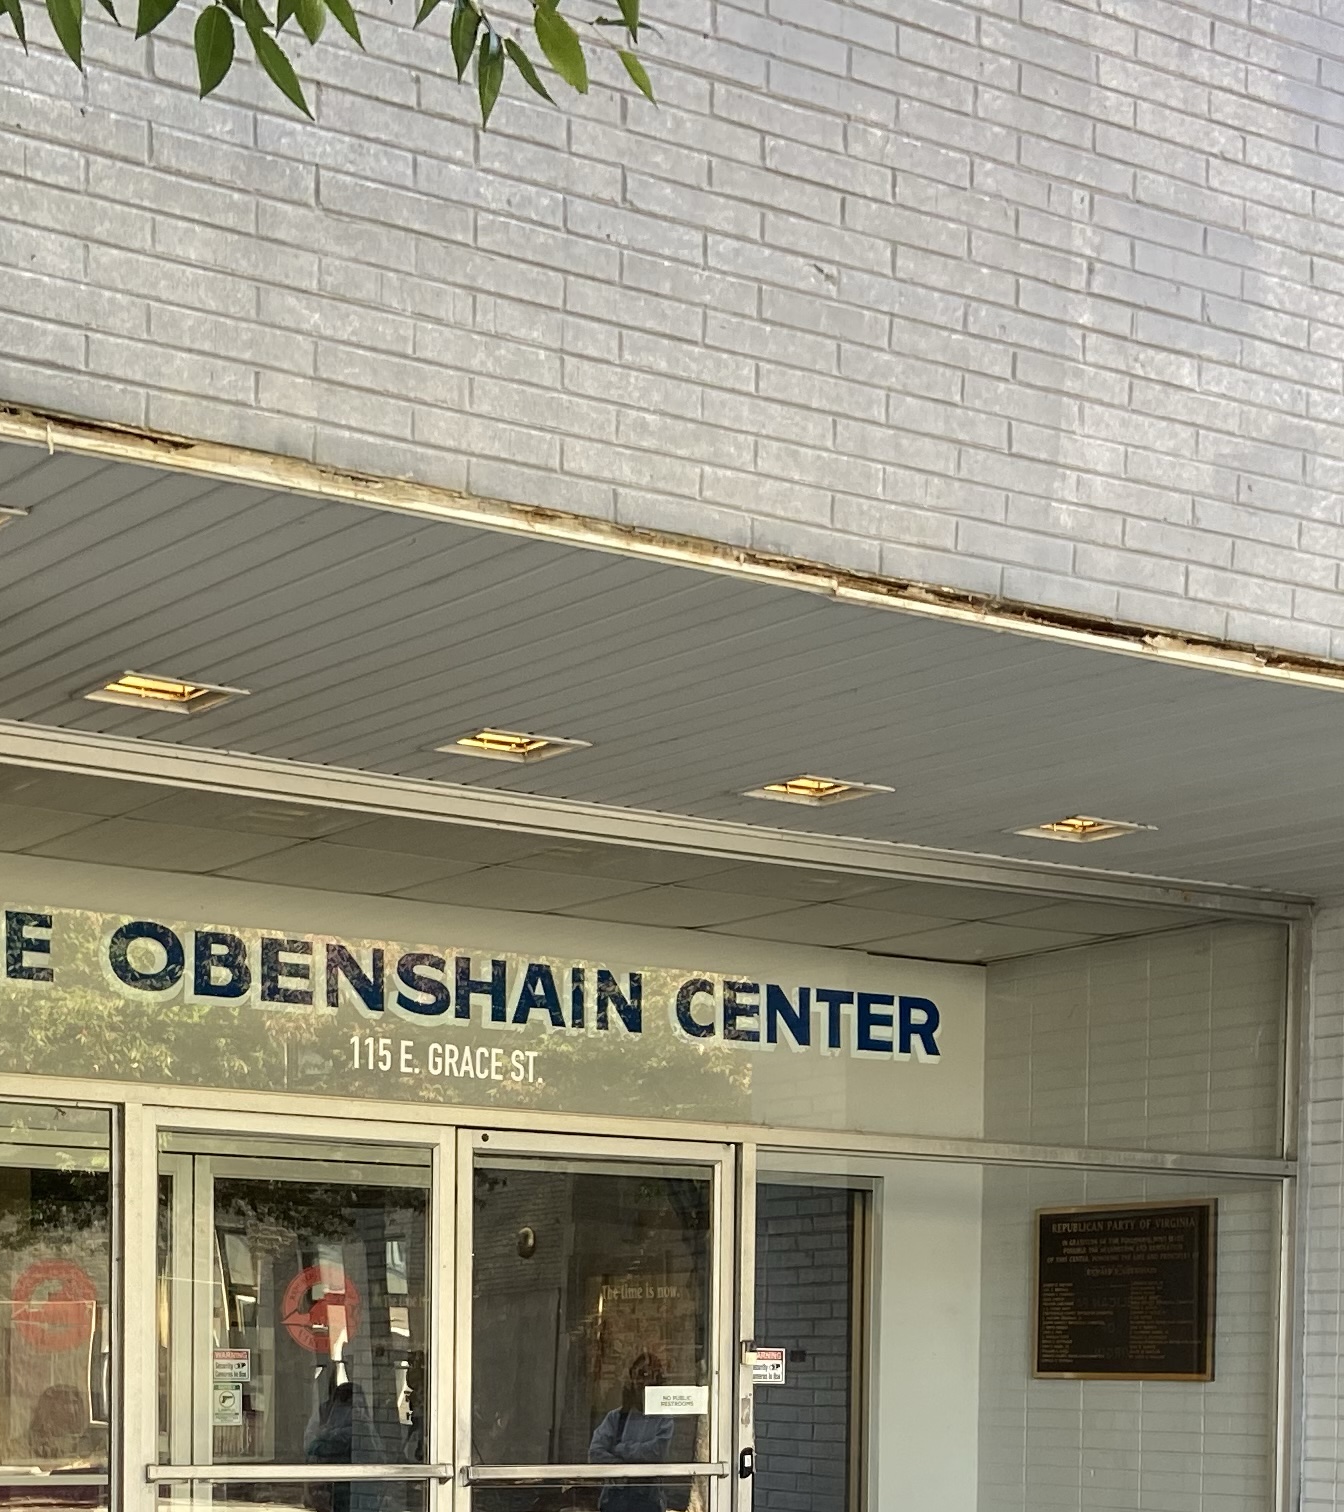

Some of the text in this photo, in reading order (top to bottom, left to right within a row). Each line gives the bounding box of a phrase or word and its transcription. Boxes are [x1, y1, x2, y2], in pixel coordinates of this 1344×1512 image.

[109, 921, 642, 1033] OBENSHAIN
[675, 977, 941, 1057] CENTER
[349, 1035, 545, 1084] 115 E. GRACE ST.
[1051, 1221, 1104, 1233] REPUBLICAN
[1107, 1220, 1136, 1231] PARTY
[1139, 1219, 1152, 1230] OF
[757, 1351, 781, 1359] ARNING
